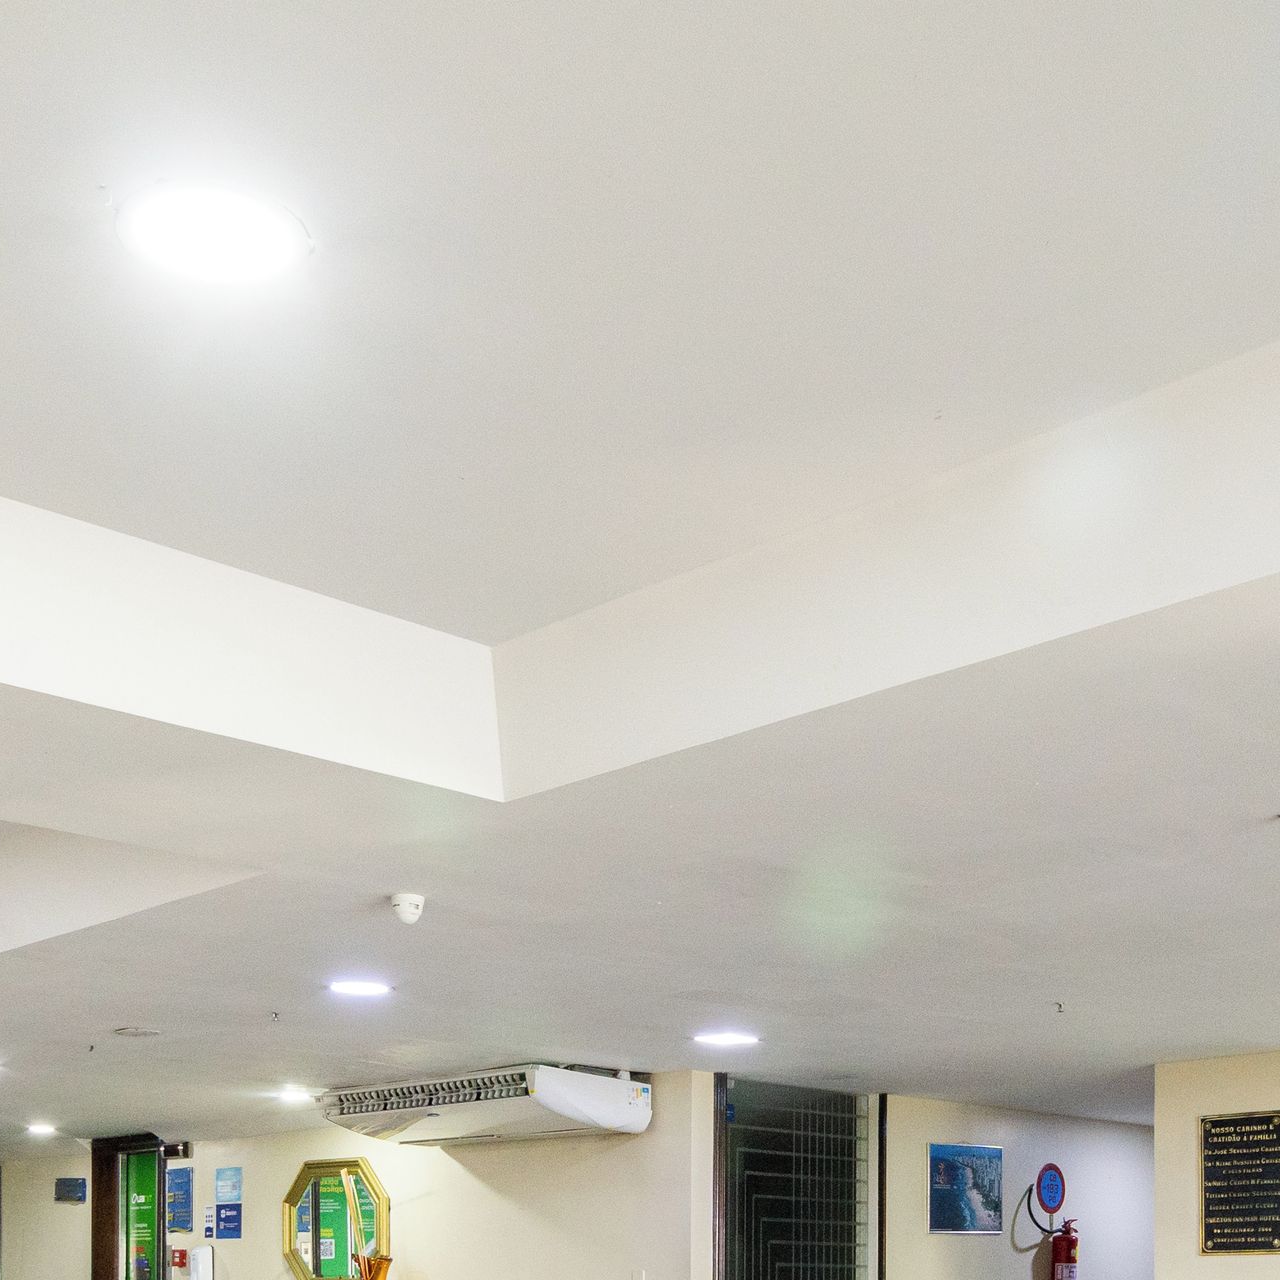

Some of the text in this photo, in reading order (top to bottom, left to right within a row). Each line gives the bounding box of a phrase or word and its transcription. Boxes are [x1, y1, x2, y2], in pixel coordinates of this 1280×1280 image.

[1211, 1126, 1234, 1134] NOSSO
[1236, 1124, 1267, 1132] CARINHO
[1208, 1133, 1241, 1143] GRATIDÃO
[1249, 1132, 1277, 1141] FAMÍLIA
